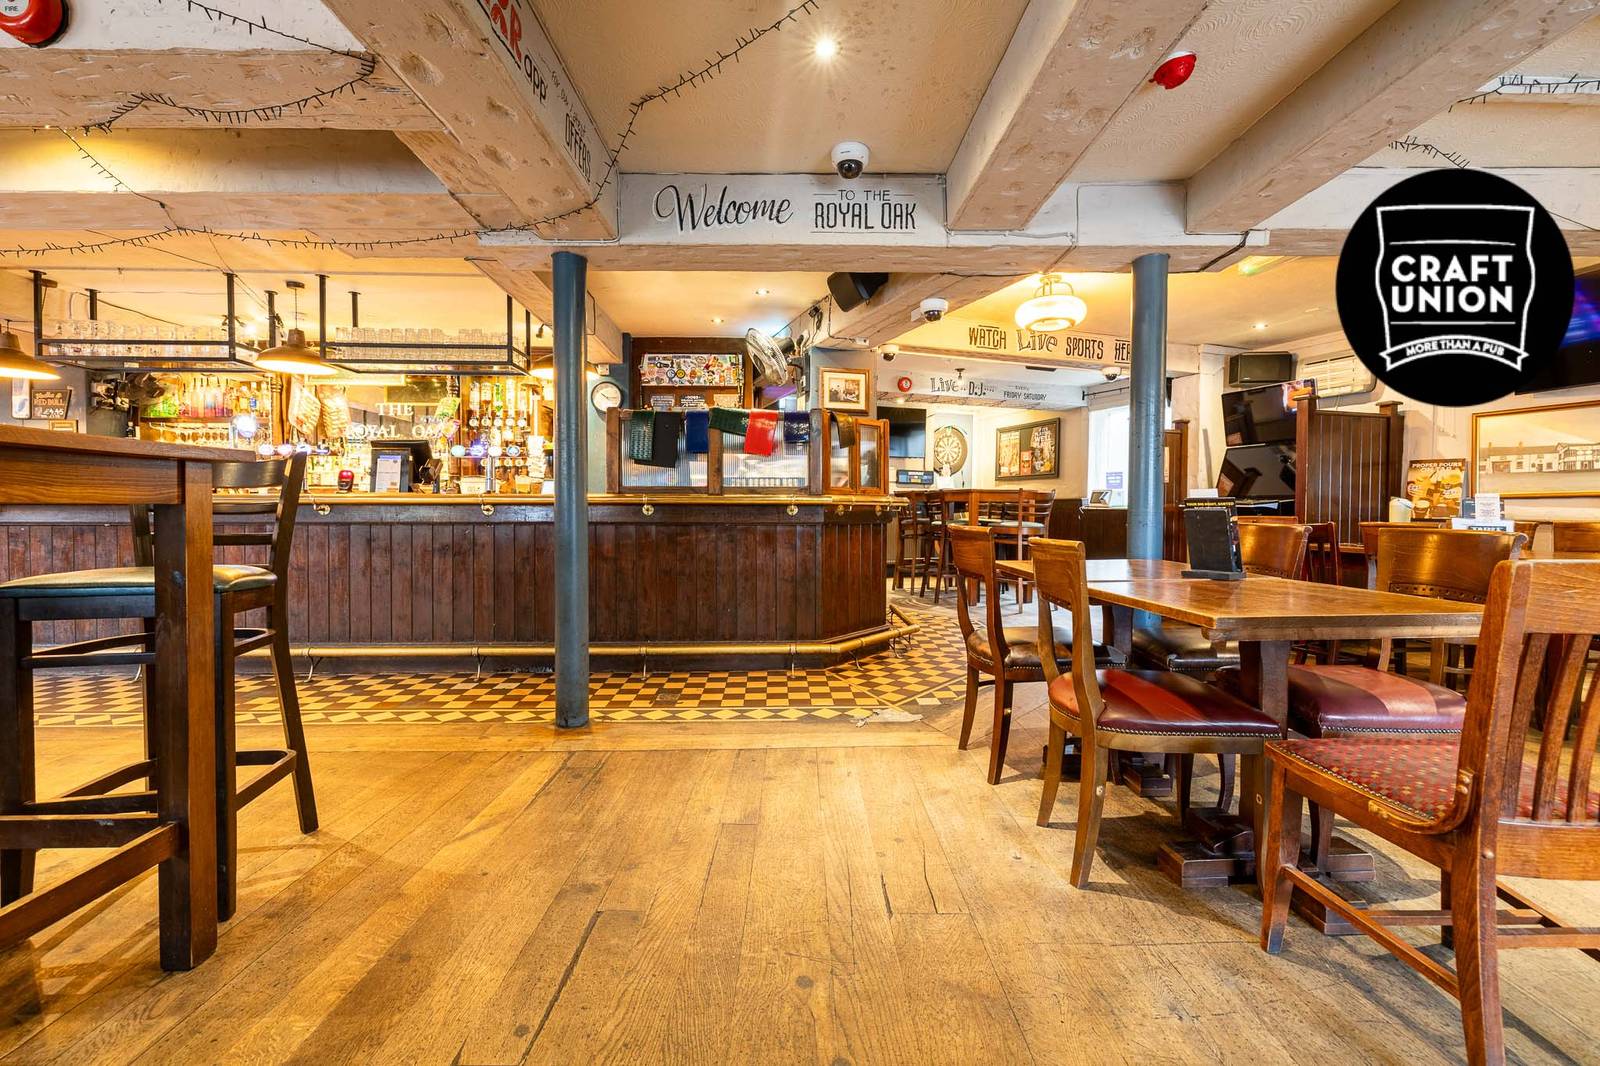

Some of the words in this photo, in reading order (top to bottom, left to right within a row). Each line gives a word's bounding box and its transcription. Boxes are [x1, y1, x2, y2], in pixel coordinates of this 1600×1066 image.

[838, 189, 855, 201] TO
[864, 190, 891, 201] THE
[655, 184, 794, 232] Welcome
[814, 202, 874, 230] ROYAL
[881, 202, 917, 230] OAK
[968, 326, 1007, 350] WATCH
[1016, 328, 1058, 352] Live
[1065, 336, 1104, 360] SPORTS
[930, 377, 959, 393] Live
[1003, 391, 1022, 400] FRIDAY
[1023, 392, 1047, 401] SATURDAY
[375, 403, 414, 416] THE
